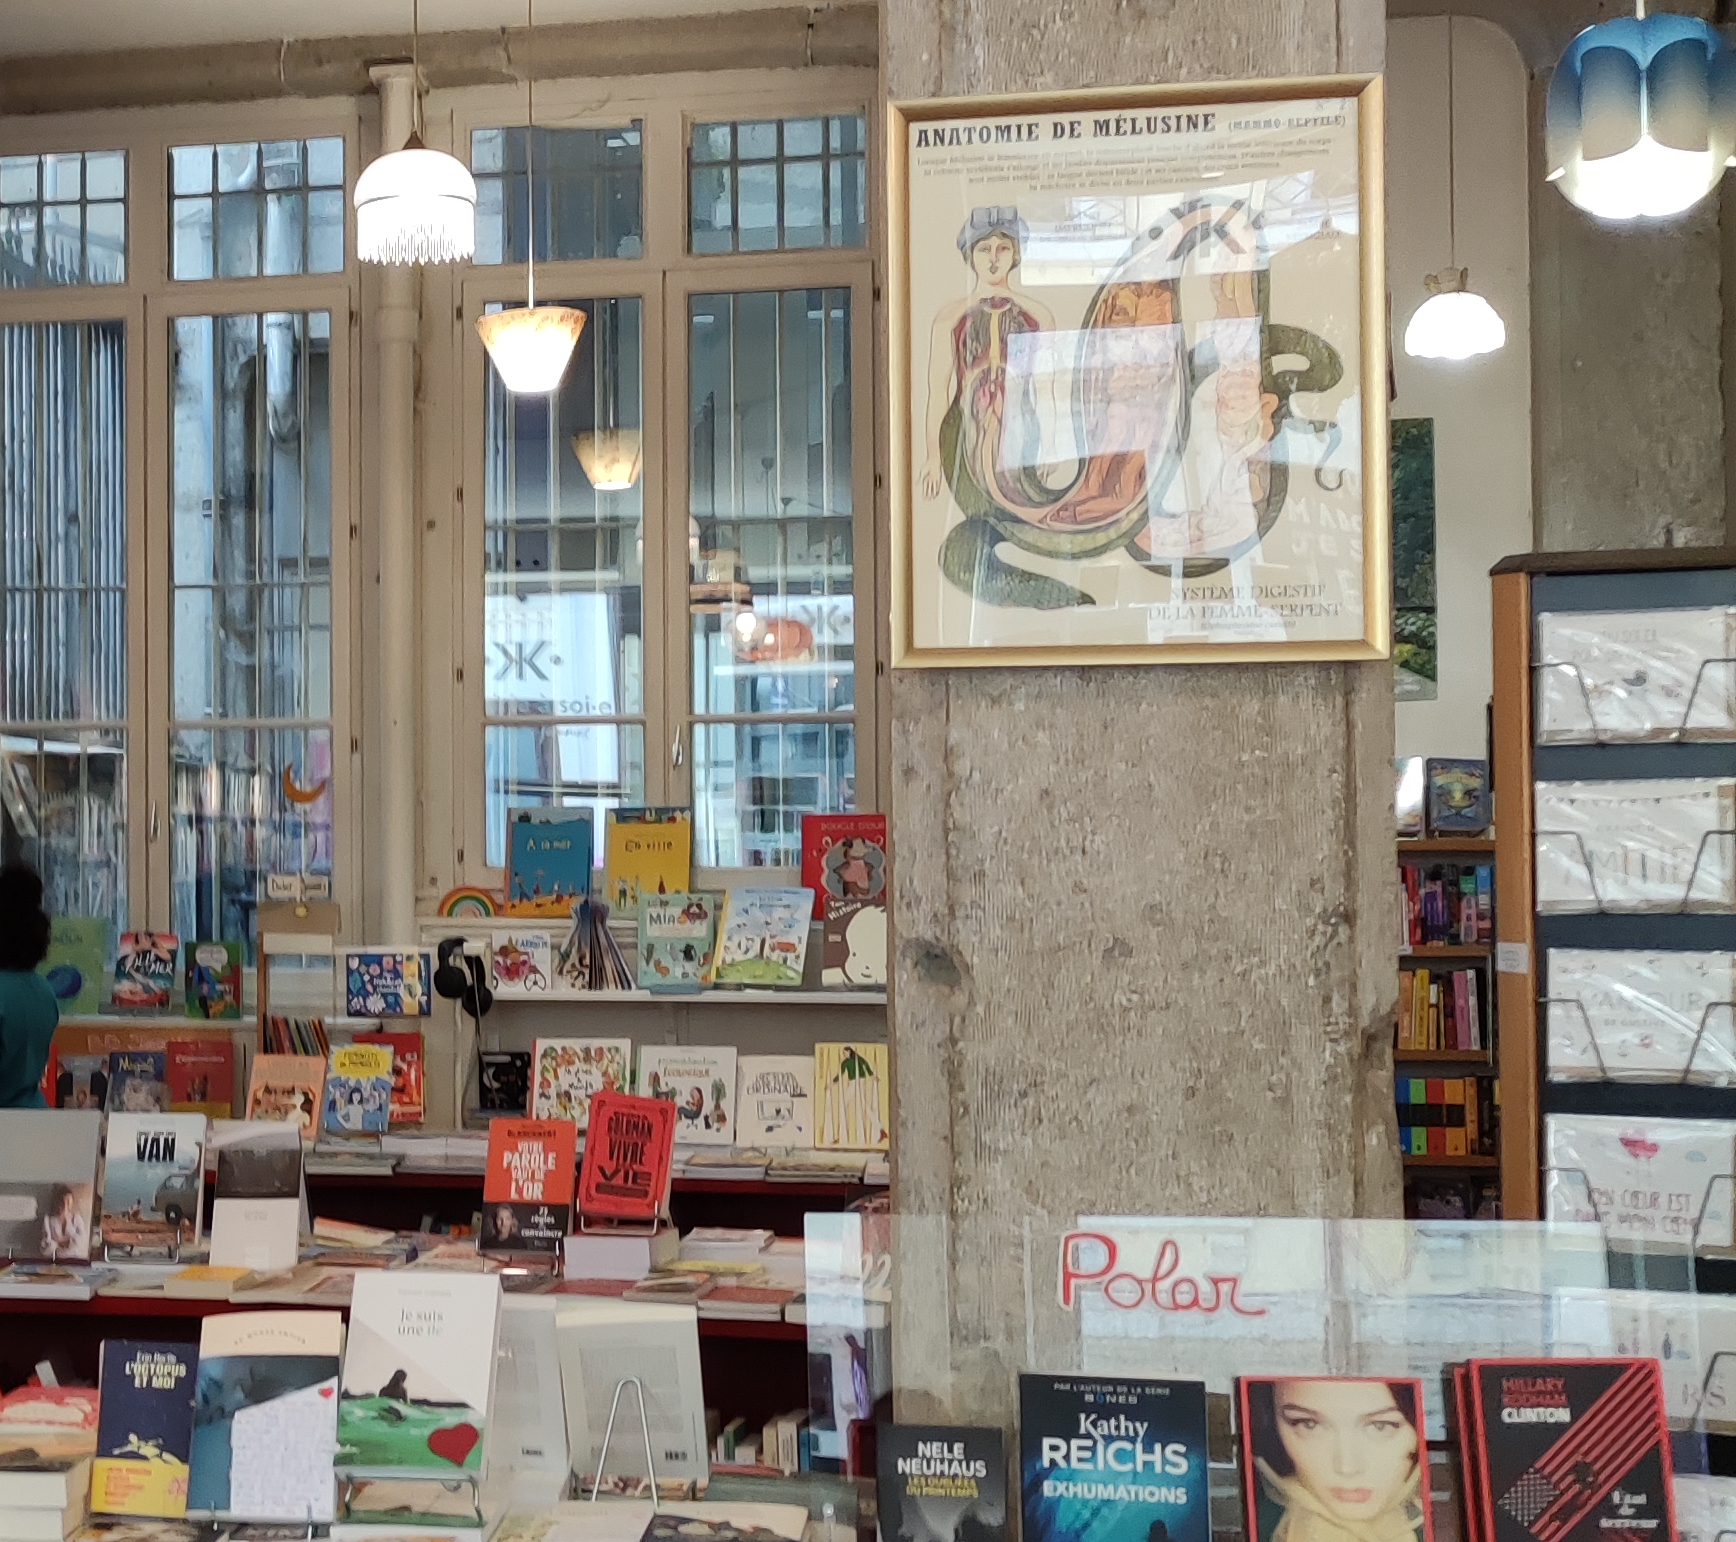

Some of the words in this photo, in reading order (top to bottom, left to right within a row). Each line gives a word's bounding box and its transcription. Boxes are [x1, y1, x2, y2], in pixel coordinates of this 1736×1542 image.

[916, 122, 1040, 149] ANATOMIE
[1052, 117, 1082, 140] DE
[1091, 112, 1216, 139] MÉLUSINE
[136, 1135, 176, 1163] VAN
[503, 1150, 557, 1170] PAROLE
[510, 1179, 544, 1201] L'OR
[1061, 1231, 1268, 1316] Polar
[400, 1308, 413, 1322] Je
[417, 1309, 444, 1322] suis
[1502, 1376, 1565, 1392] HILLARY
[1501, 1407, 1572, 1423] CLINTON
[1078, 1412, 1149, 1443] Kathy
[917, 1441, 965, 1459] NELE
[1041, 1436, 1189, 1476] REICHS
[897, 1457, 987, 1478] NEUHAUS
[1042, 1479, 1188, 1505] EXHUMATIONS
